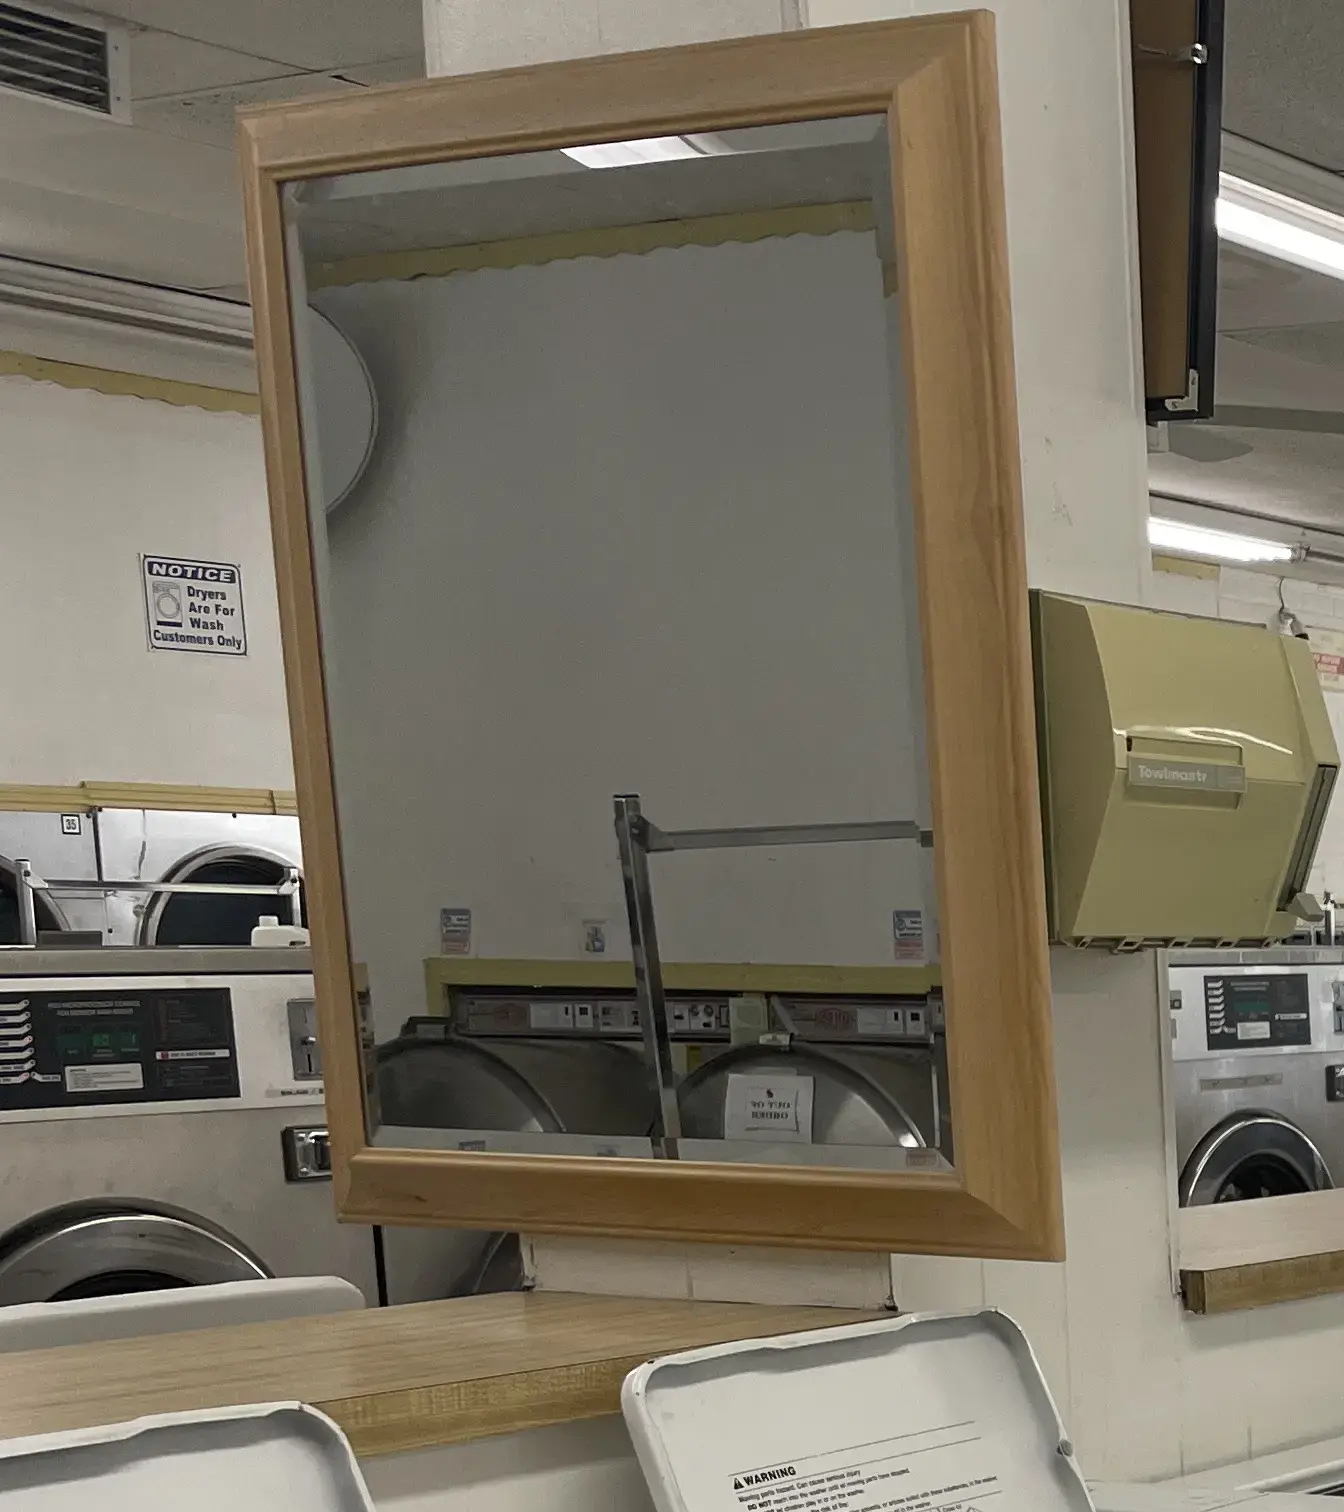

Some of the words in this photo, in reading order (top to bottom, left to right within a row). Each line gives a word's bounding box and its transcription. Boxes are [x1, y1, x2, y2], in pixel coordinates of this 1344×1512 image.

[152, 563, 232, 582] NOTICE
[187, 586, 227, 601] Dryers
[189, 602, 211, 614] Are
[215, 604, 235, 616] For
[190, 617, 224, 631] Wash
[153, 630, 214, 645] Customers
[217, 635, 242, 650] Only
[65, 818, 77, 832] 35
[743, 1466, 797, 1486] WARNING
